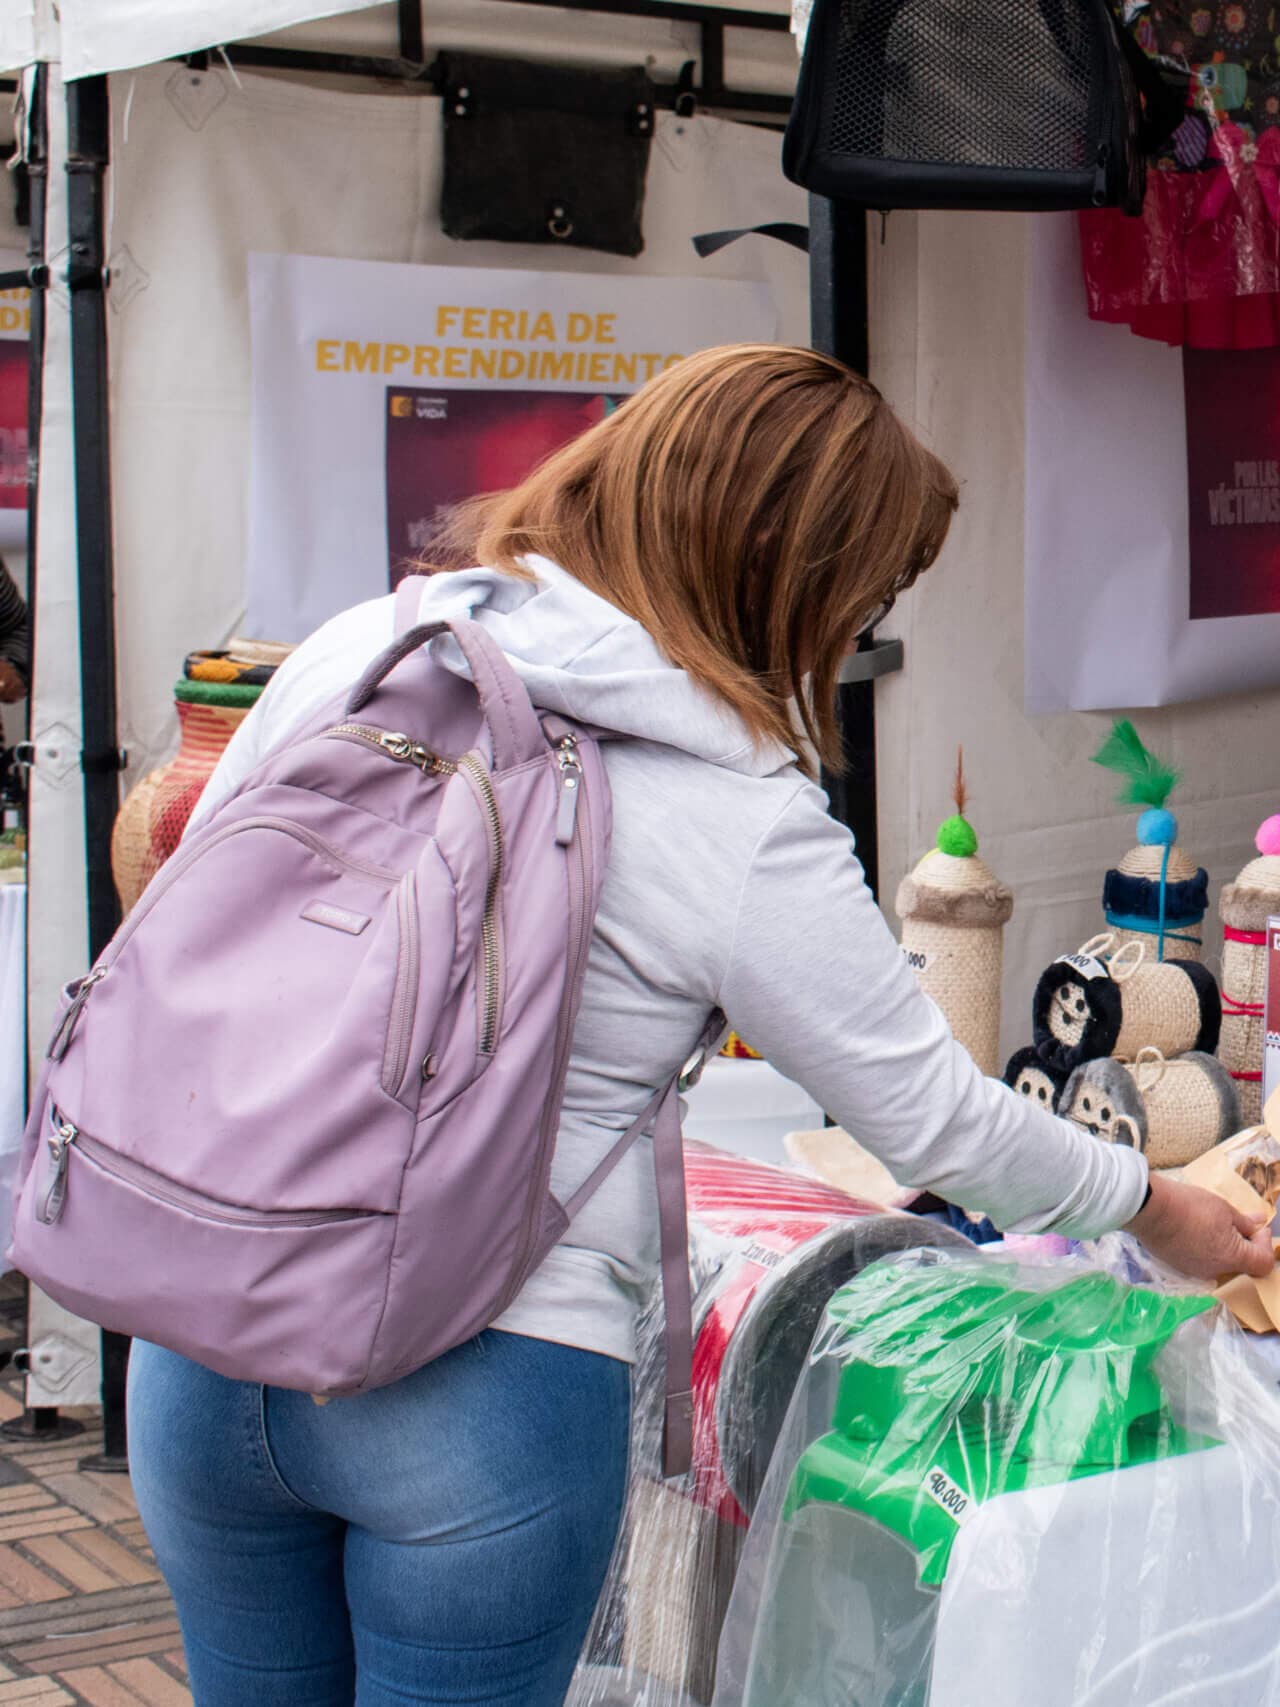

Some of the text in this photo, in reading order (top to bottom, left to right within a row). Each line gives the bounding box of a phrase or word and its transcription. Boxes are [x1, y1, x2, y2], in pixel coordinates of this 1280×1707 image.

[435, 305, 617, 343] FERIA DE
[416, 408, 447, 420] VIDA
